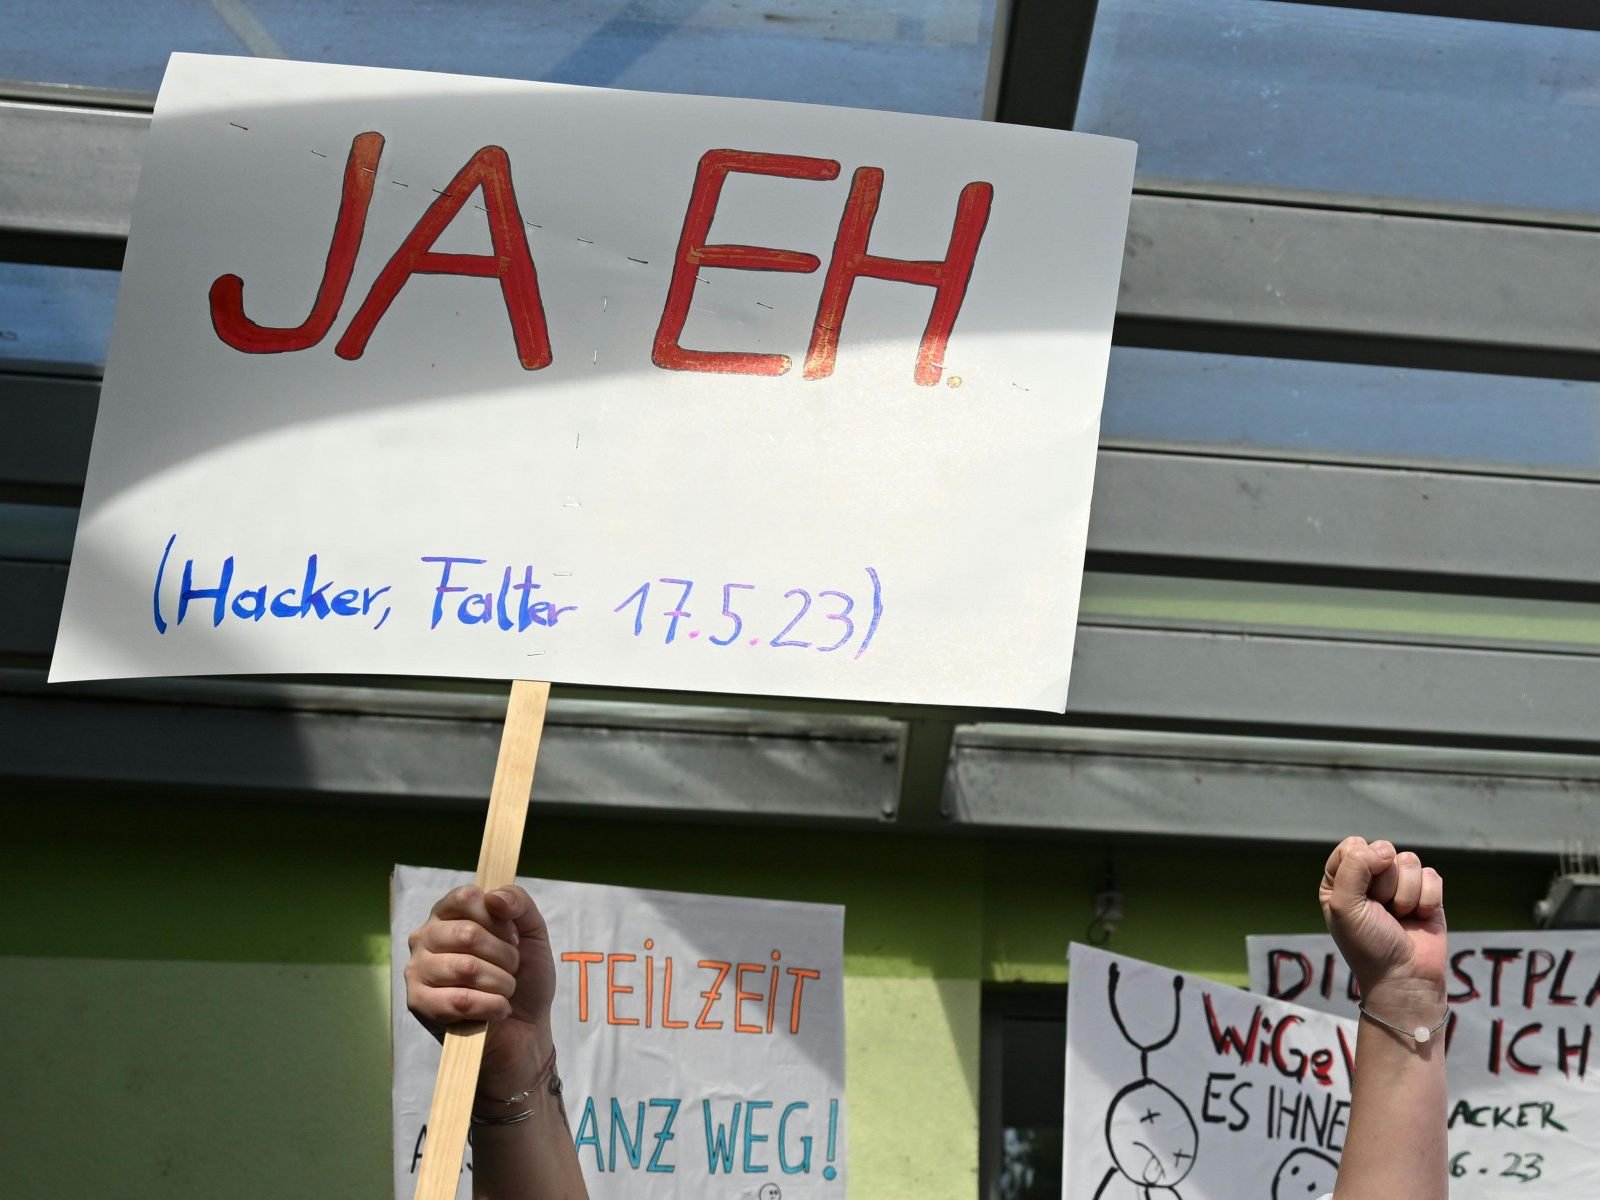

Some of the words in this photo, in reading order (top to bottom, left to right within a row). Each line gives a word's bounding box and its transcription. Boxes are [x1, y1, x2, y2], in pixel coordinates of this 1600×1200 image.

[208, 131, 553, 371] JA
[152, 535, 391, 634] (Hacker,
[420, 556, 578, 631] Falter
[614, 567, 883, 660] 17.5.23)
[702, 1098, 839, 1181] WEG!
[1202, 1072, 1253, 1132] ES
